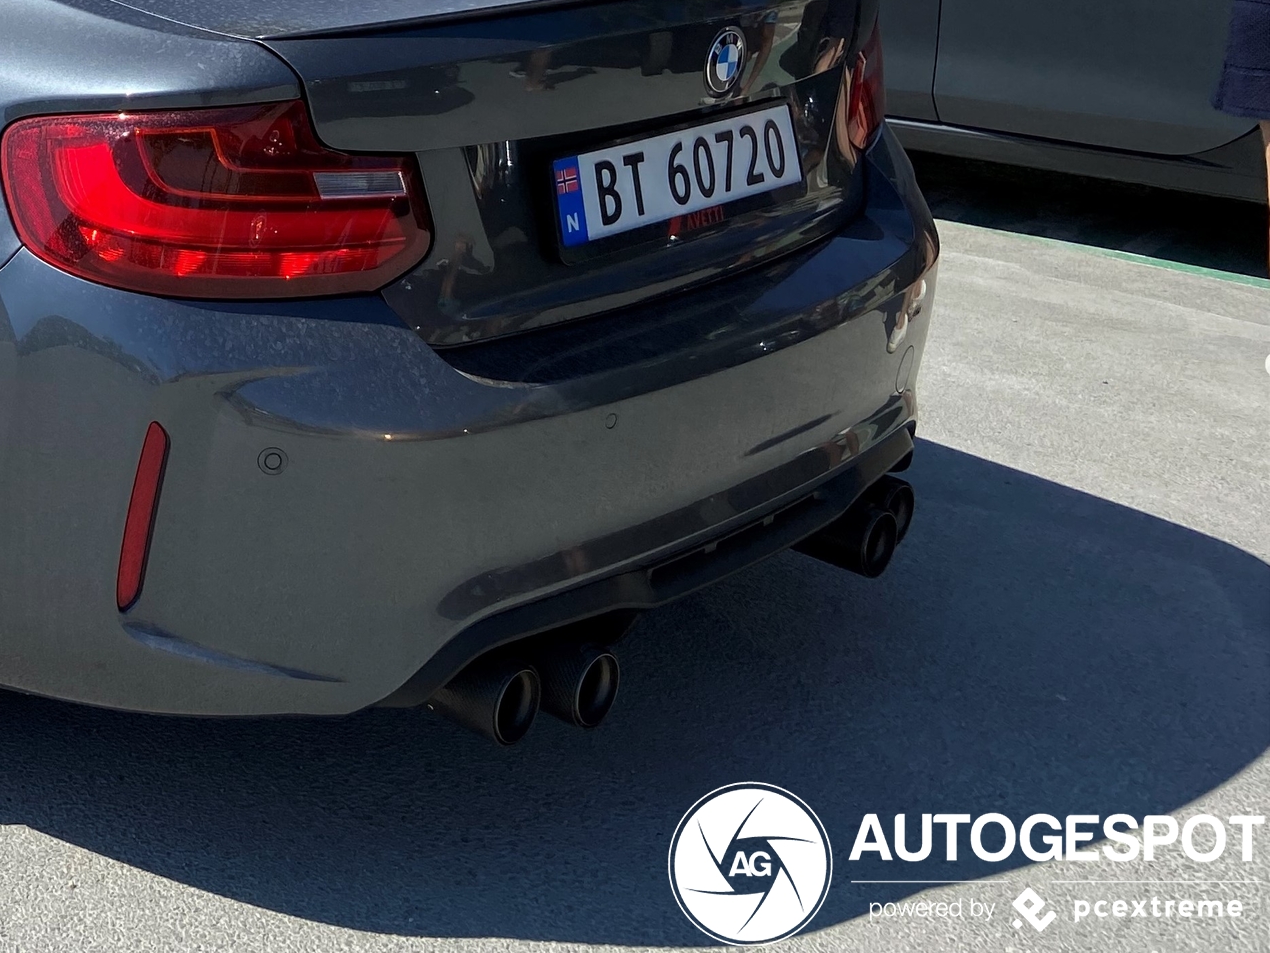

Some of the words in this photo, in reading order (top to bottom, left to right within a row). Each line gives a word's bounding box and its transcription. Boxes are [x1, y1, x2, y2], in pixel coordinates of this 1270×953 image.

[594, 151, 645, 226] BT
[667, 118, 785, 206] 60720
[566, 212, 580, 233] N
